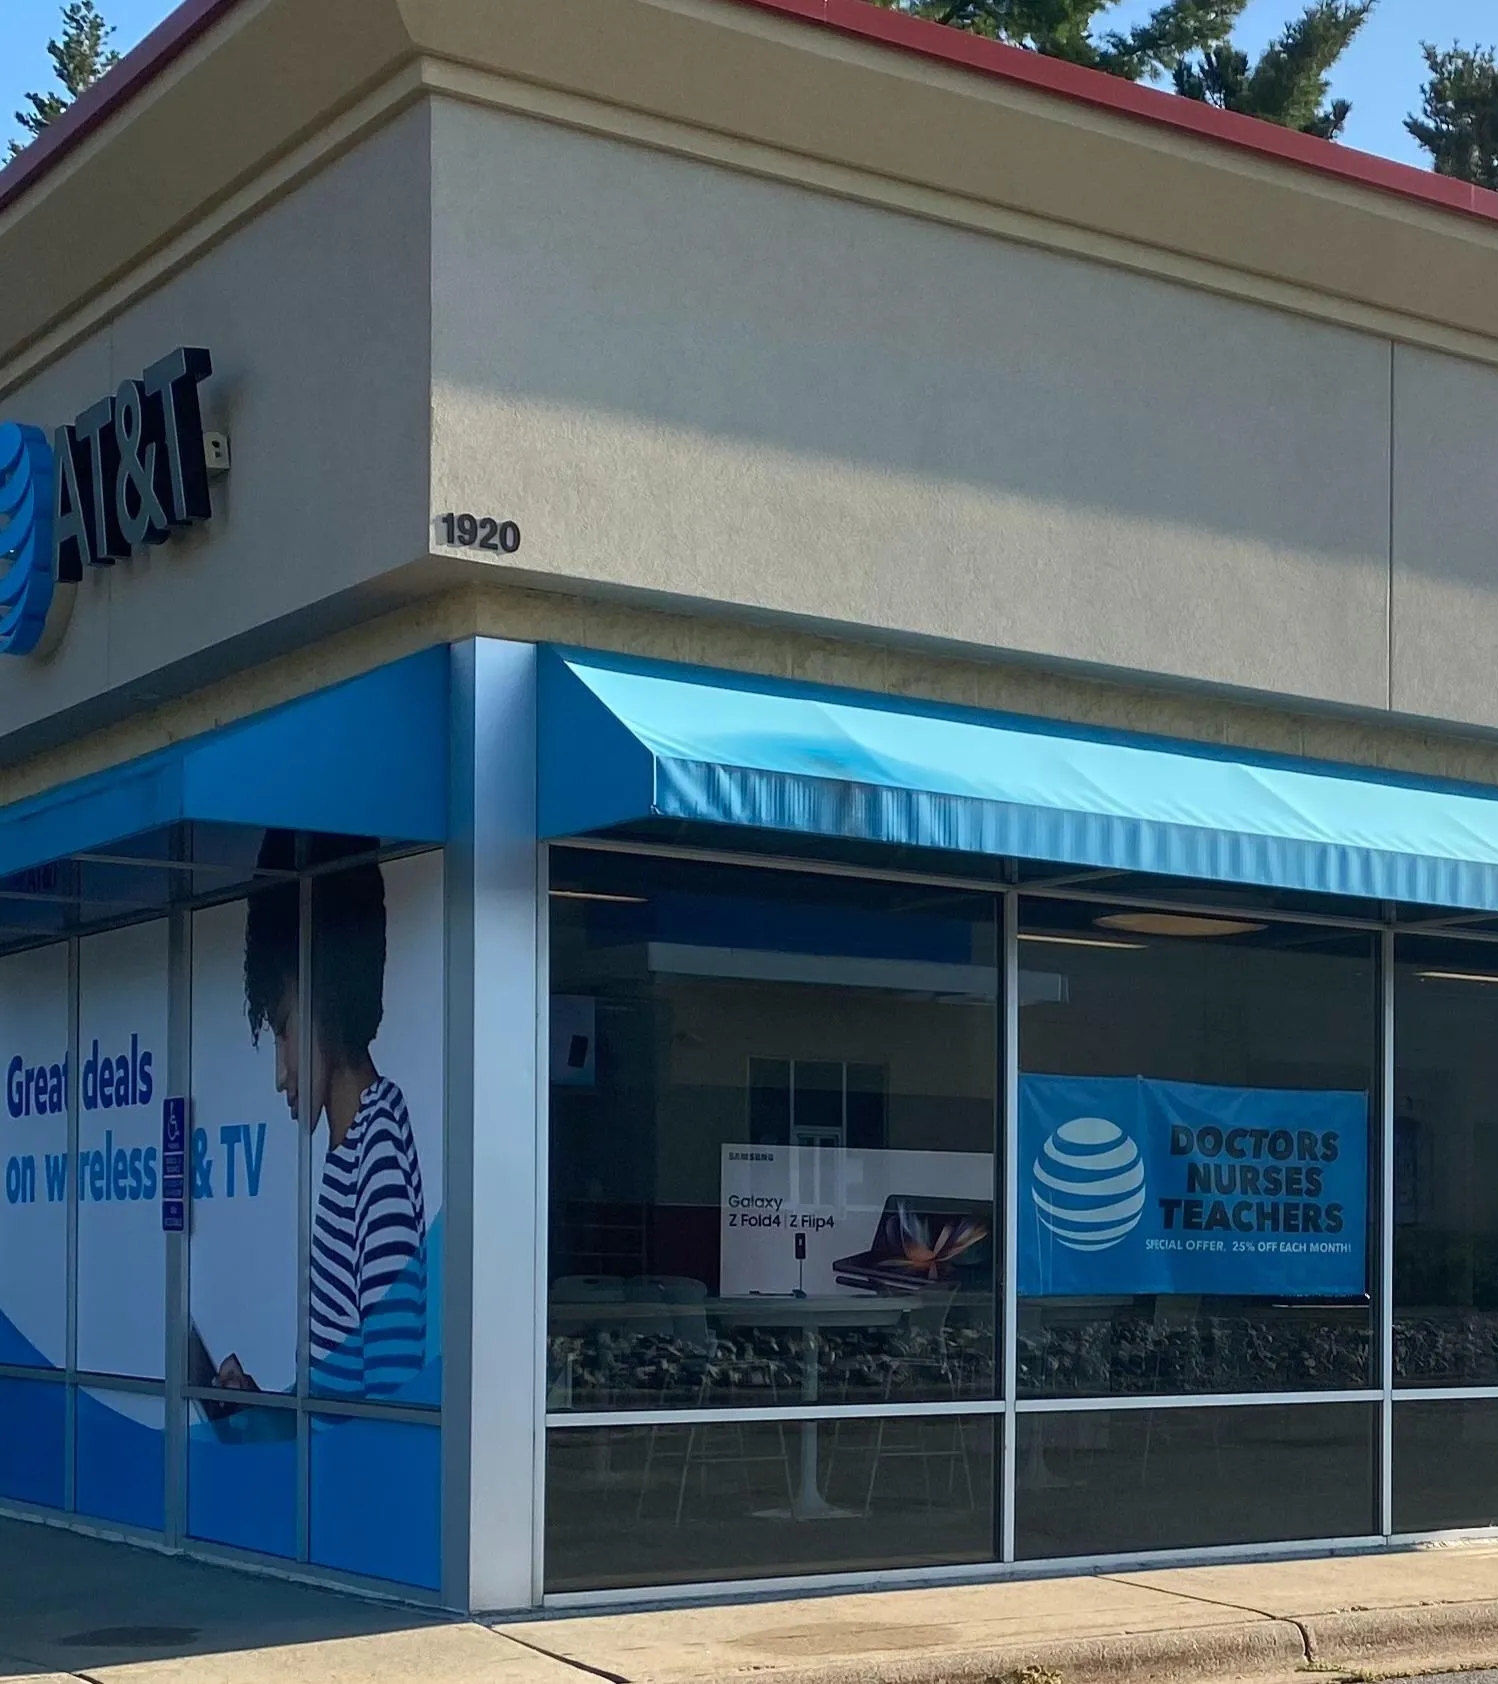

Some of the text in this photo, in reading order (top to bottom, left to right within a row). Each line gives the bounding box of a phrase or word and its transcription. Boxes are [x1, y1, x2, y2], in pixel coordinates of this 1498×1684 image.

[53, 346, 212, 583] AT&T
[442, 512, 521, 553] 1920
[82, 1033, 153, 1111] deals
[728, 1151, 774, 1162] SAMSUNG
[1170, 1124, 1340, 1162] DOCTORS
[6, 1123, 267, 1204] on wreless & TV
[1187, 1163, 1323, 1198] NURSES
[728, 1194, 783, 1212] Galaxy
[1158, 1198, 1344, 1234] TEACHERS
[729, 1213, 835, 1232] Z Fold4 Z Flip4
[1145, 1239, 1352, 1253] SPECIAL OFFER. 25% OFF EACH MONTH!
